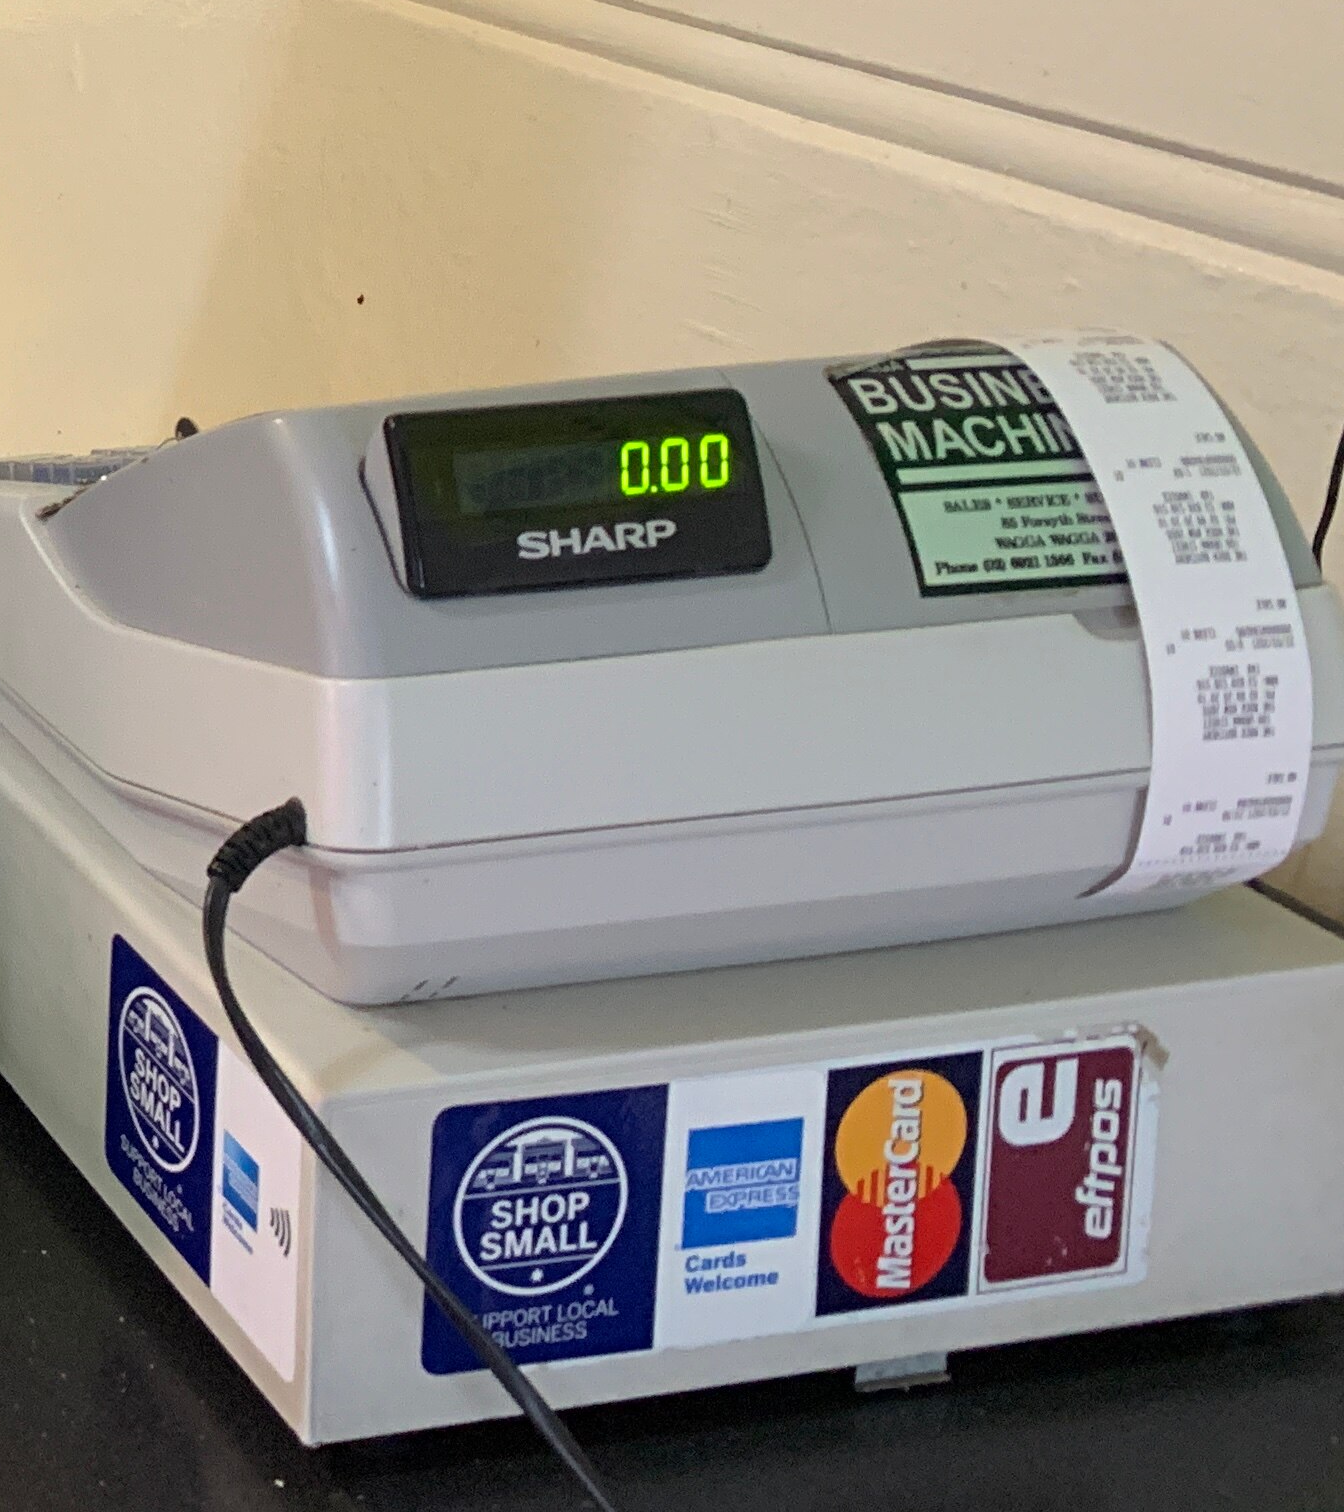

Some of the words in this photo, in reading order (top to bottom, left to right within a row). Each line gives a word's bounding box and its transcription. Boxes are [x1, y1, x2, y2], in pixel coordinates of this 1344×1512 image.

[621, 434, 729, 496] 0.00
[518, 519, 676, 559] SHARP
[995, 536, 1046, 548] WAGGA
[1051, 533, 1099, 546] WAGGA
[936, 561, 978, 574] Phone
[133, 1048, 181, 1112] SHOP
[129, 1071, 186, 1155] SMALL
[686, 1161, 796, 1187] AMERICAN
[1076, 1078, 1123, 1240] eftpos
[710, 1185, 799, 1209] EXPRESS
[876, 1078, 923, 1289] MasterCard
[490, 1191, 590, 1229] SHOP
[479, 1219, 598, 1263] SMALL
[685, 1252, 746, 1272] Cards
[685, 1269, 778, 1293] Welcome
[473, 1305, 552, 1330] PPORT
[556, 1298, 620, 1322] LOCAL
[491, 1322, 589, 1349] BUSINESS
